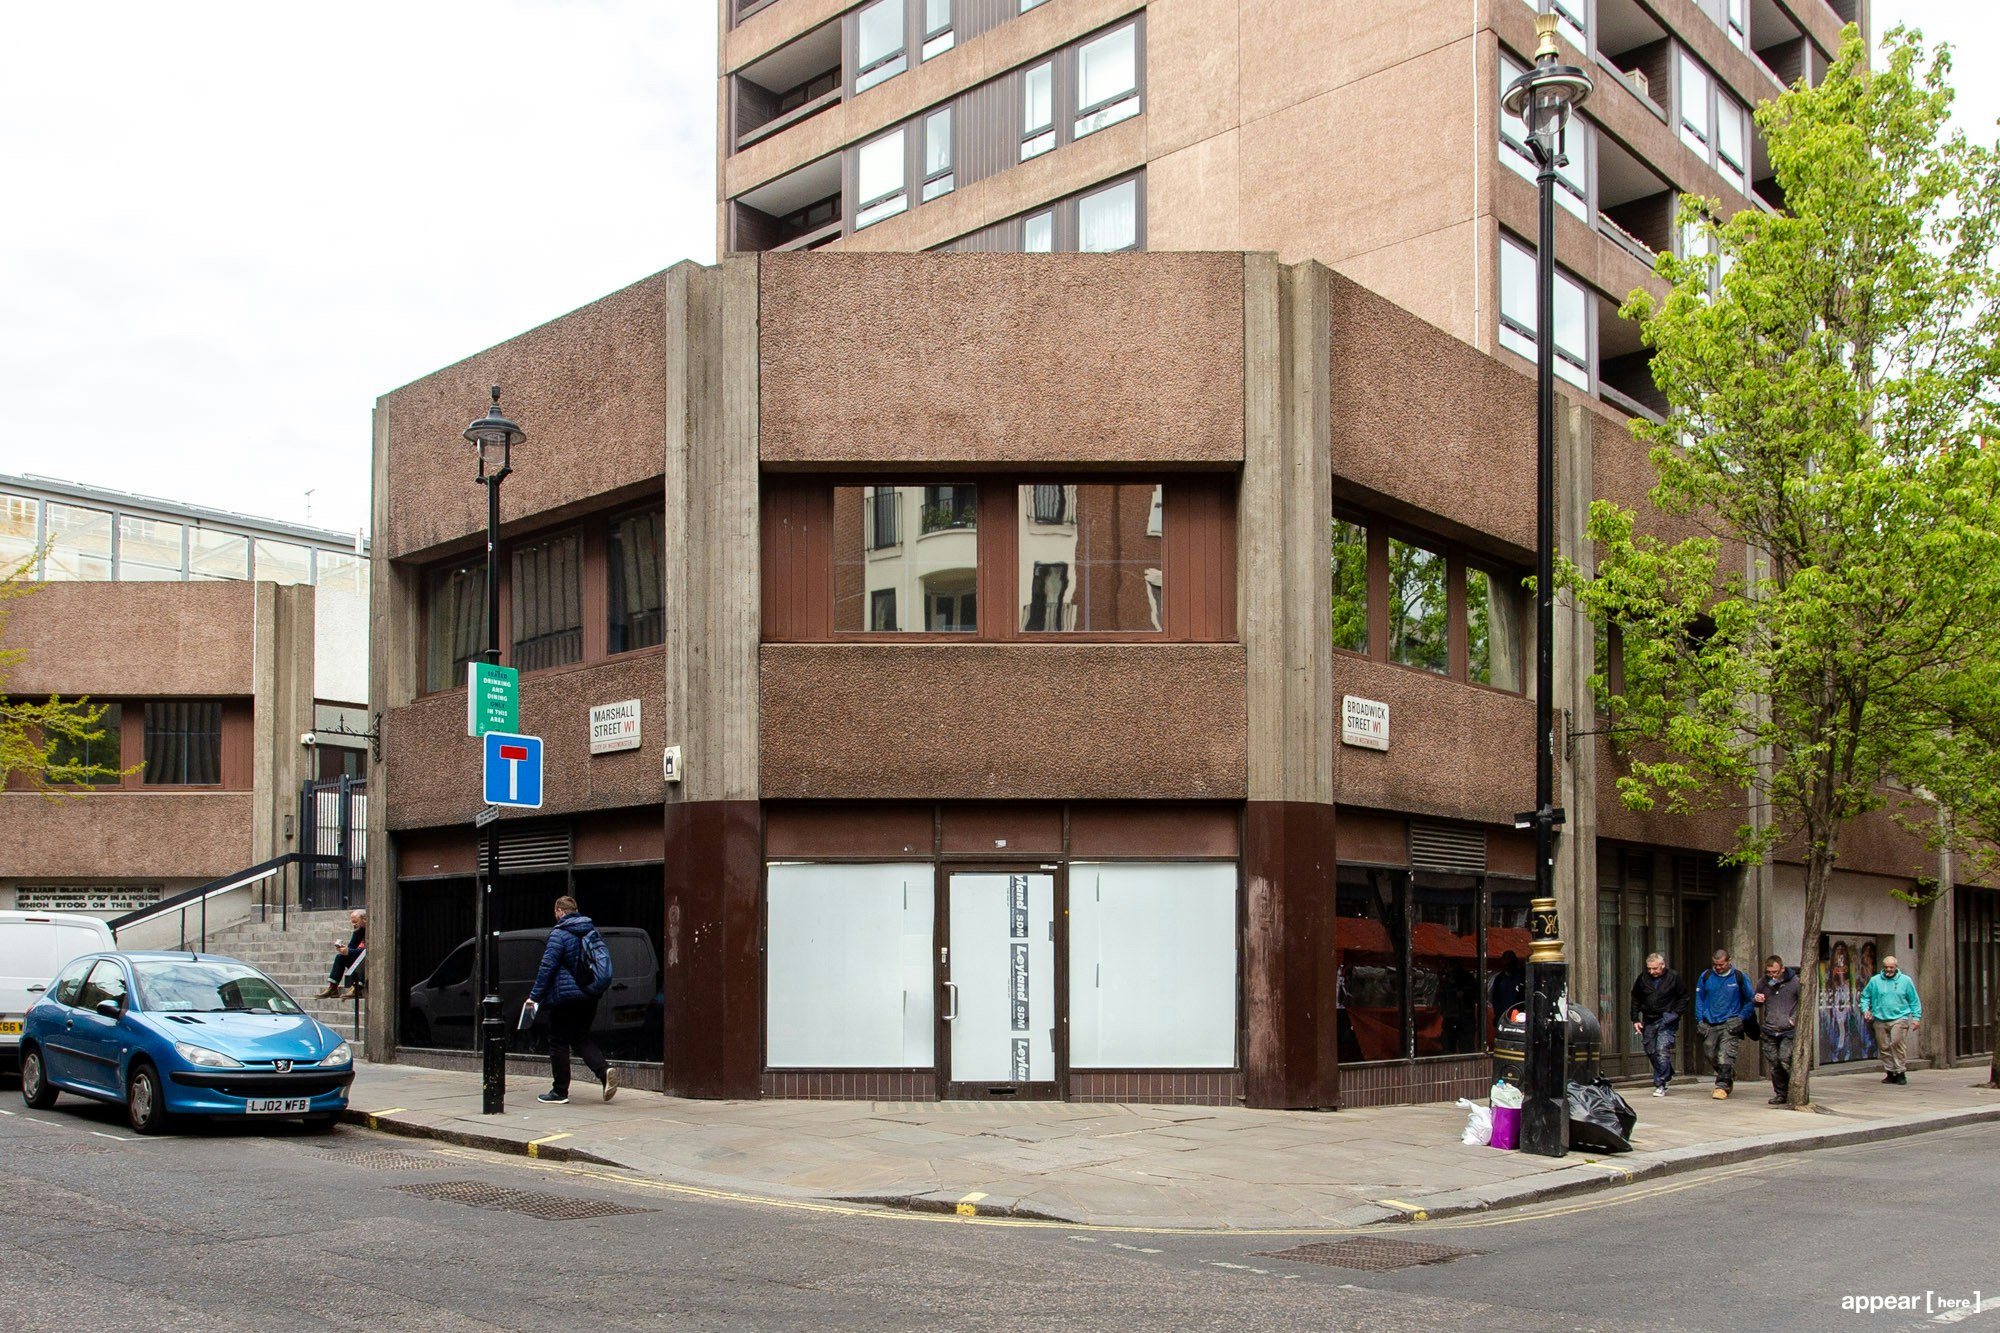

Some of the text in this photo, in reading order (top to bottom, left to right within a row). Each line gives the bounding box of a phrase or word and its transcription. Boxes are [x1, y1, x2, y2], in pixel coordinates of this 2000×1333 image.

[483, 678, 512, 688] DRINKING
[487, 693, 508, 702] DINING
[594, 705, 634, 723] MARSHALL
[1347, 700, 1386, 720] BROADWICK
[594, 720, 635, 738] STREET W1
[1348, 716, 1381, 734] STREET W1
[1016, 914, 1024, 937] SDM
[1015, 945, 1028, 1029] Leyland SDM
[251, 1100, 306, 1111] LJ02 WFB
